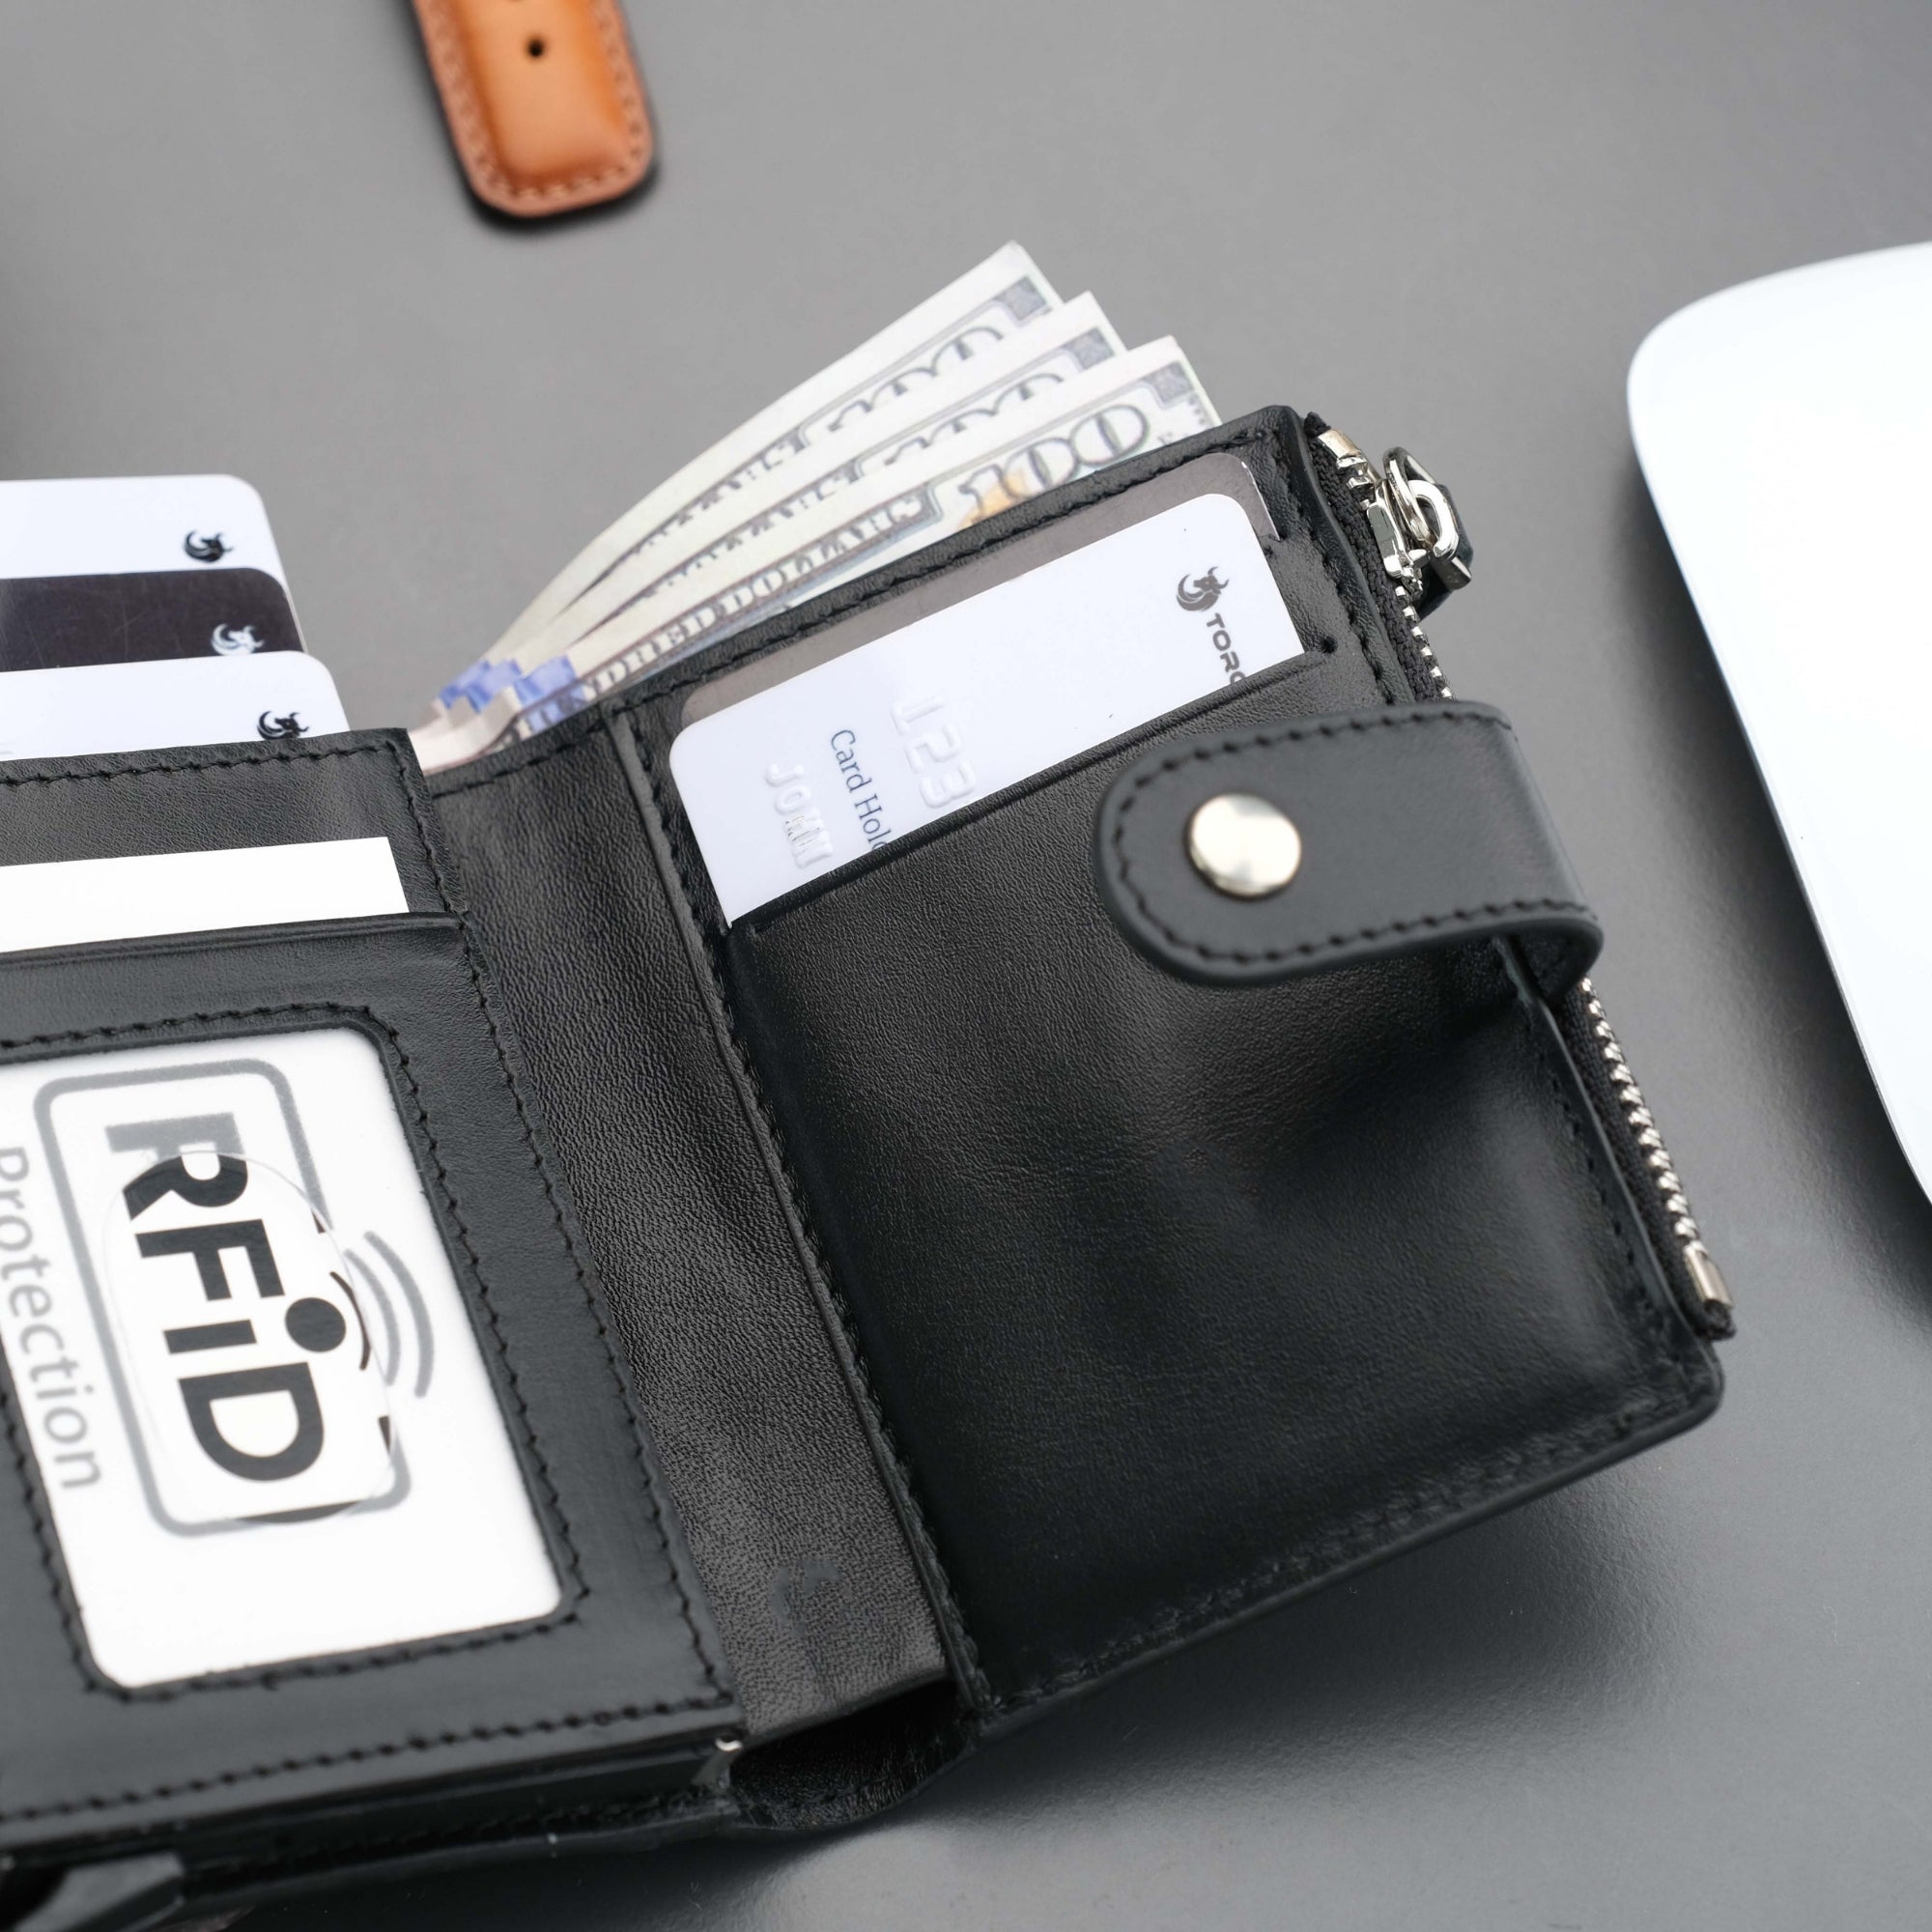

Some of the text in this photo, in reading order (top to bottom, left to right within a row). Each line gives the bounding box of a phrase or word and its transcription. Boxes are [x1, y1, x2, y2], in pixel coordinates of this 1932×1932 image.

[957, 404, 1149, 526] 100
[721, 495, 923, 615] DOLLARS
[831, 729, 872, 792] Card
[891, 695, 976, 809] 123
[0, 1147, 102, 1489] Protection
